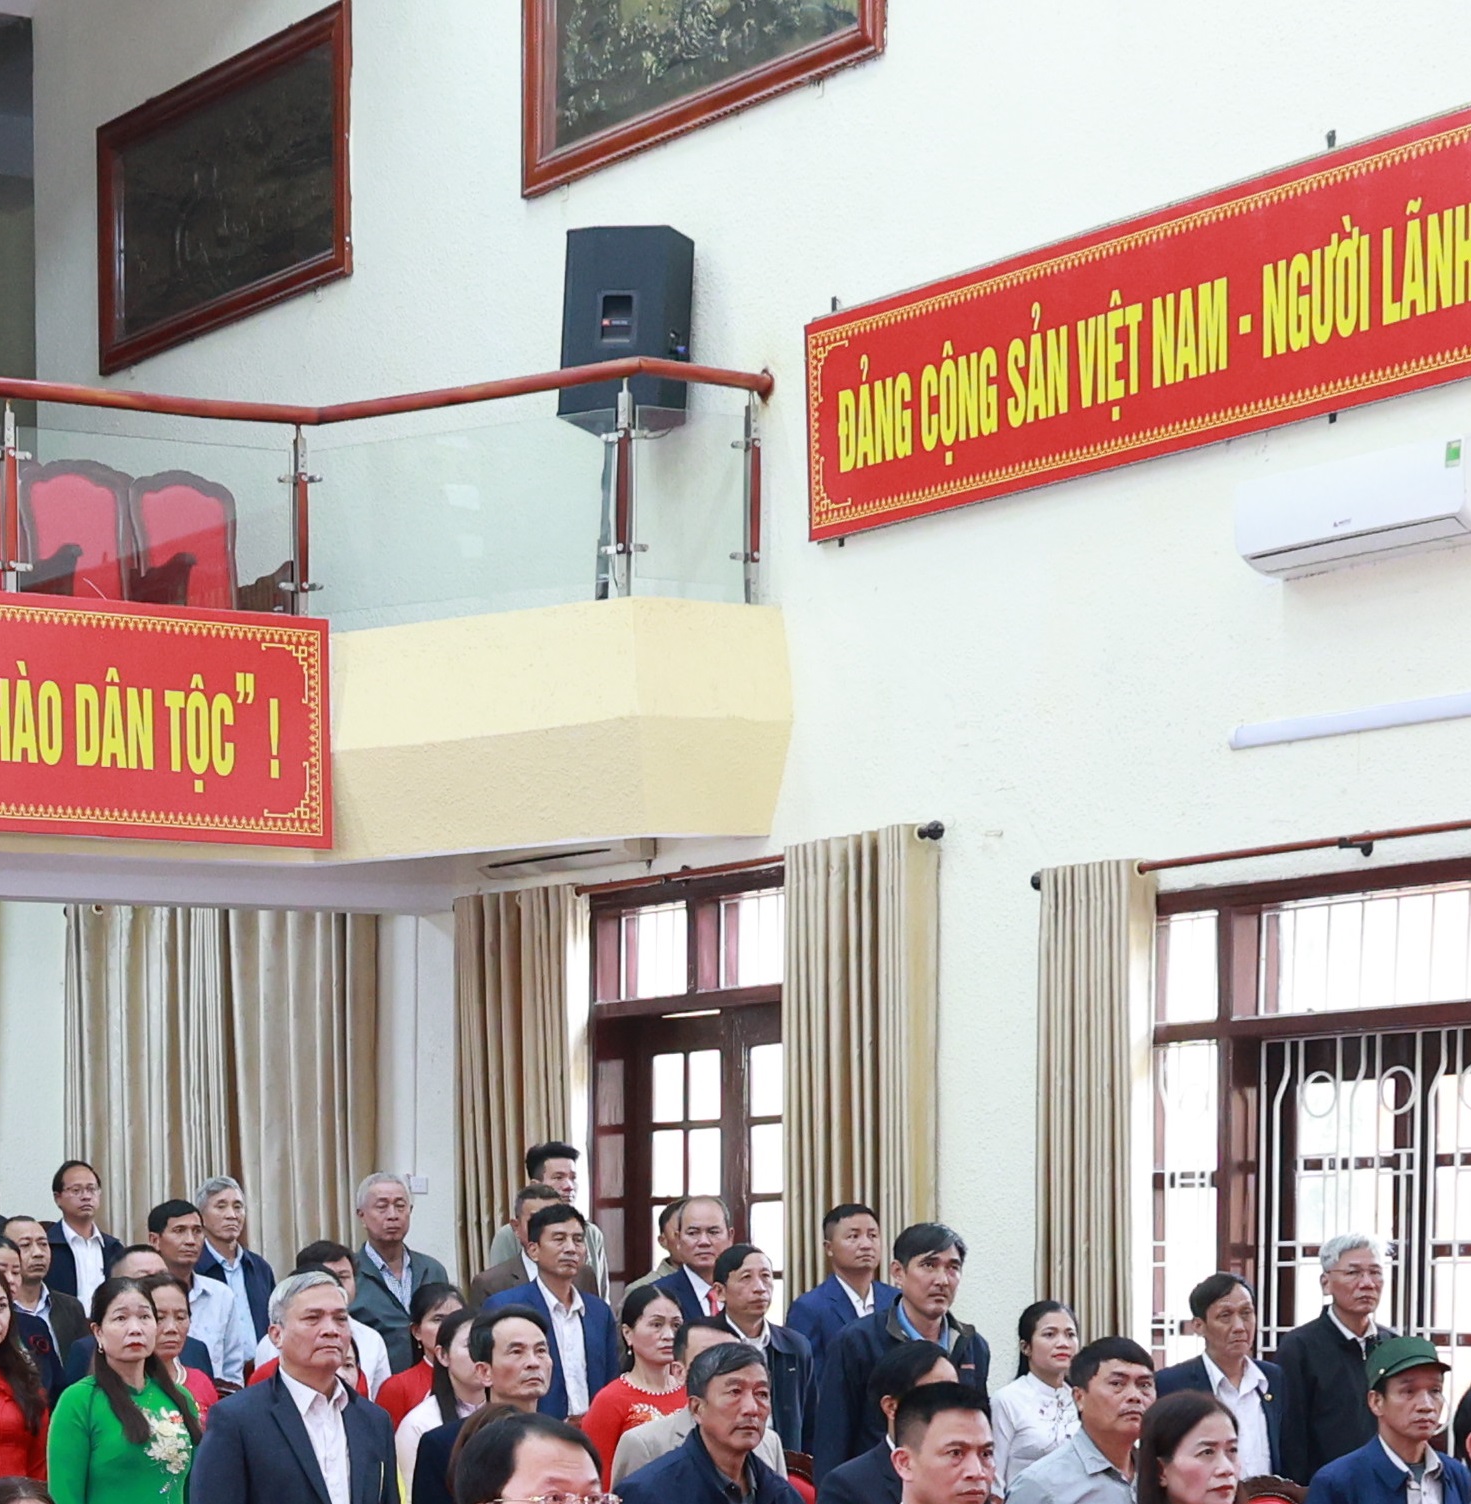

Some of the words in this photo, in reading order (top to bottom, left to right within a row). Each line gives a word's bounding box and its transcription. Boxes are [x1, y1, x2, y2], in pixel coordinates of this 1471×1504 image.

[839, 352, 913, 472] ĐẢNG
[922, 340, 997, 465] CỘNG
[1009, 302, 1068, 427] SẢN
[1079, 295, 1143, 420] VIỆT
[1154, 278, 1228, 387] NAM
[1240, 315, 1252, 333] -
[1264, 225, 1370, 357] NGƯỜI
[77, 672, 154, 769] DÂN
[270, 699, 280, 779] !
